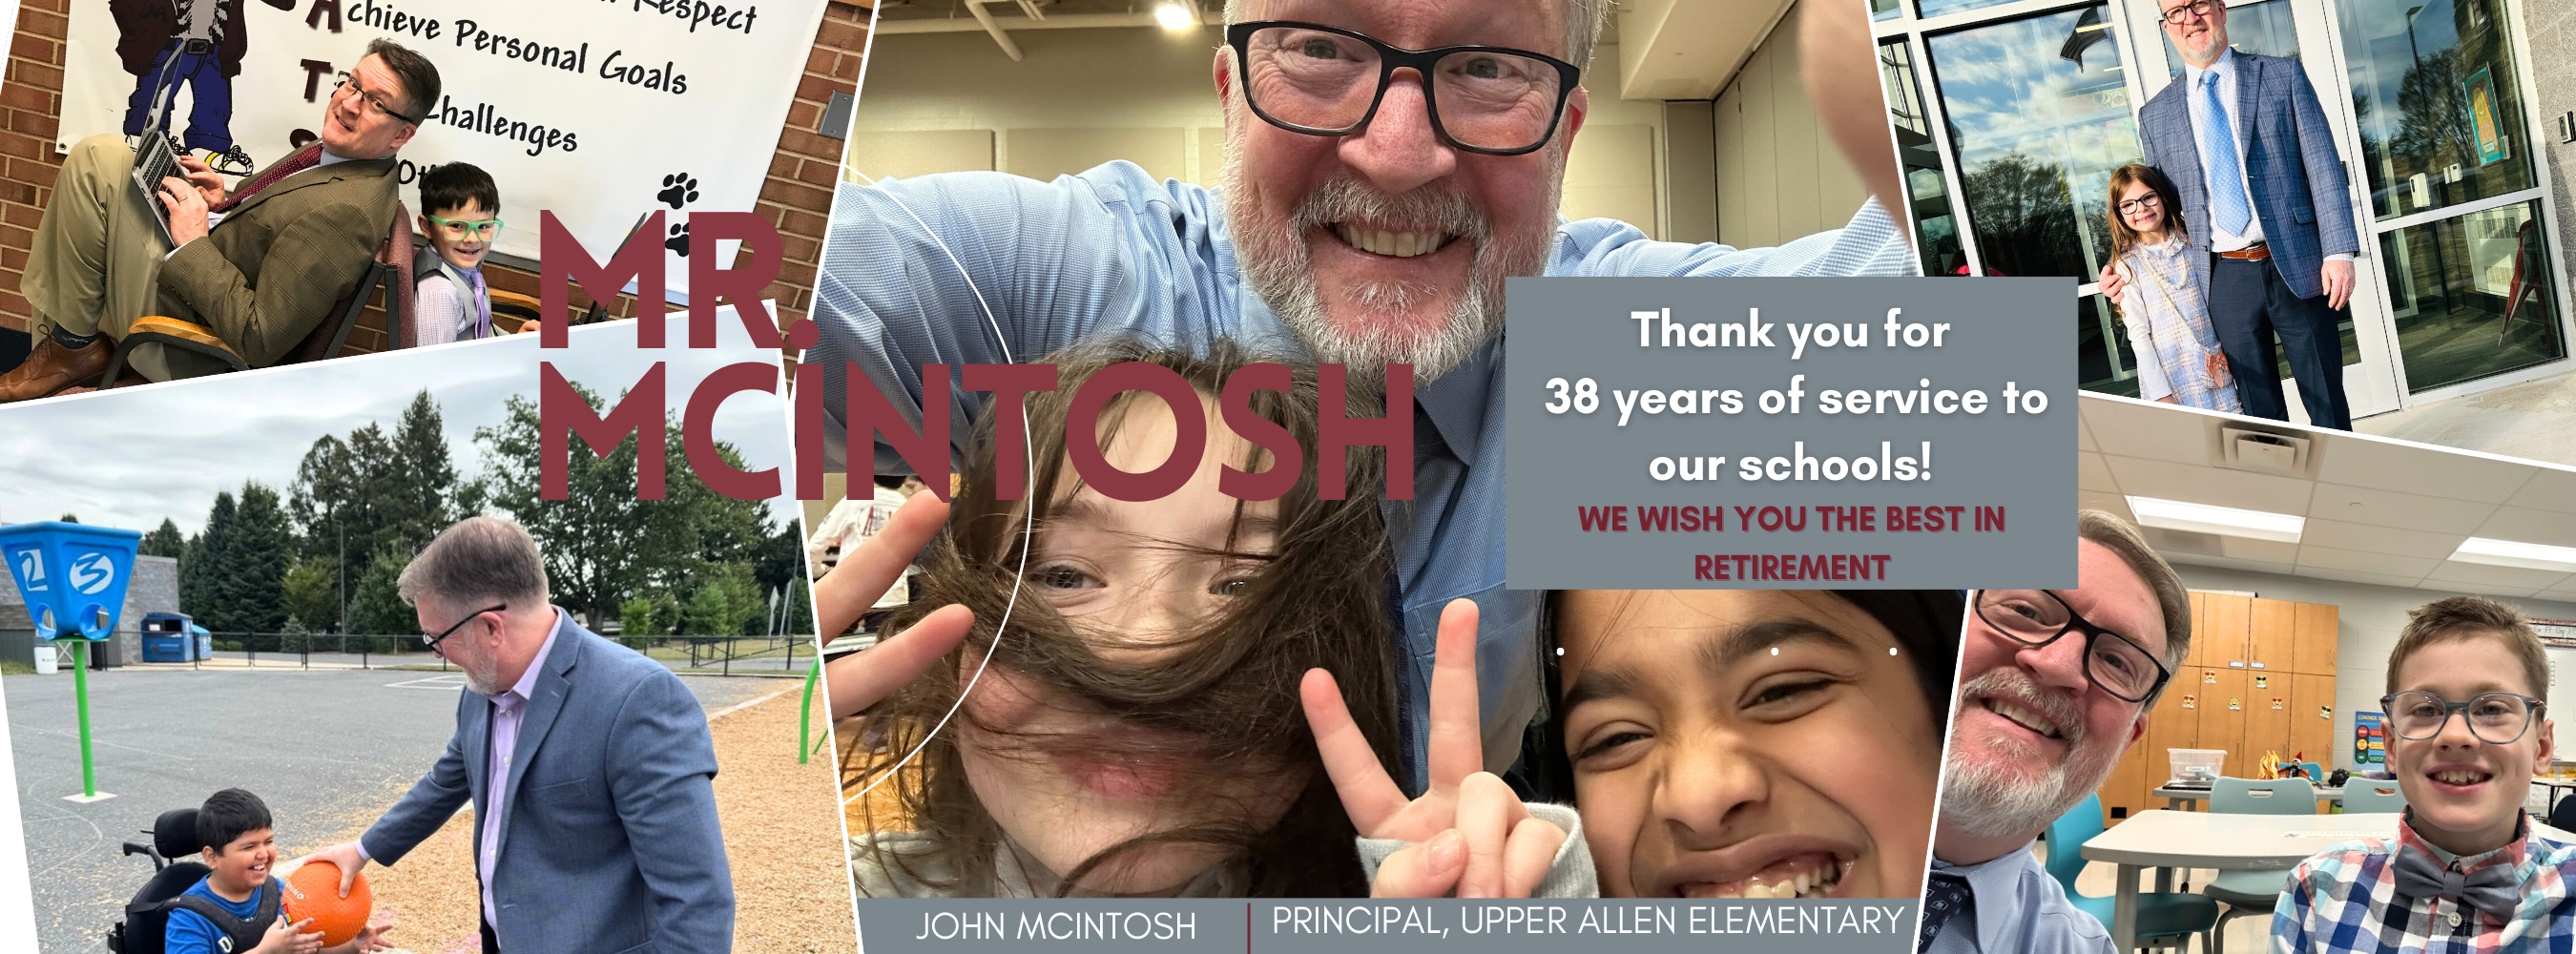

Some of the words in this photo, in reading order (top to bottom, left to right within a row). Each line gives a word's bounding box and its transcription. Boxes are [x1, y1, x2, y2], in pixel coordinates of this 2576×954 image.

[454, 19, 589, 73] Personal
[599, 50, 687, 94] Goals
[425, 94, 577, 156] hallenges
[18, 549, 48, 591] 2
[70, 552, 114, 594] 3
